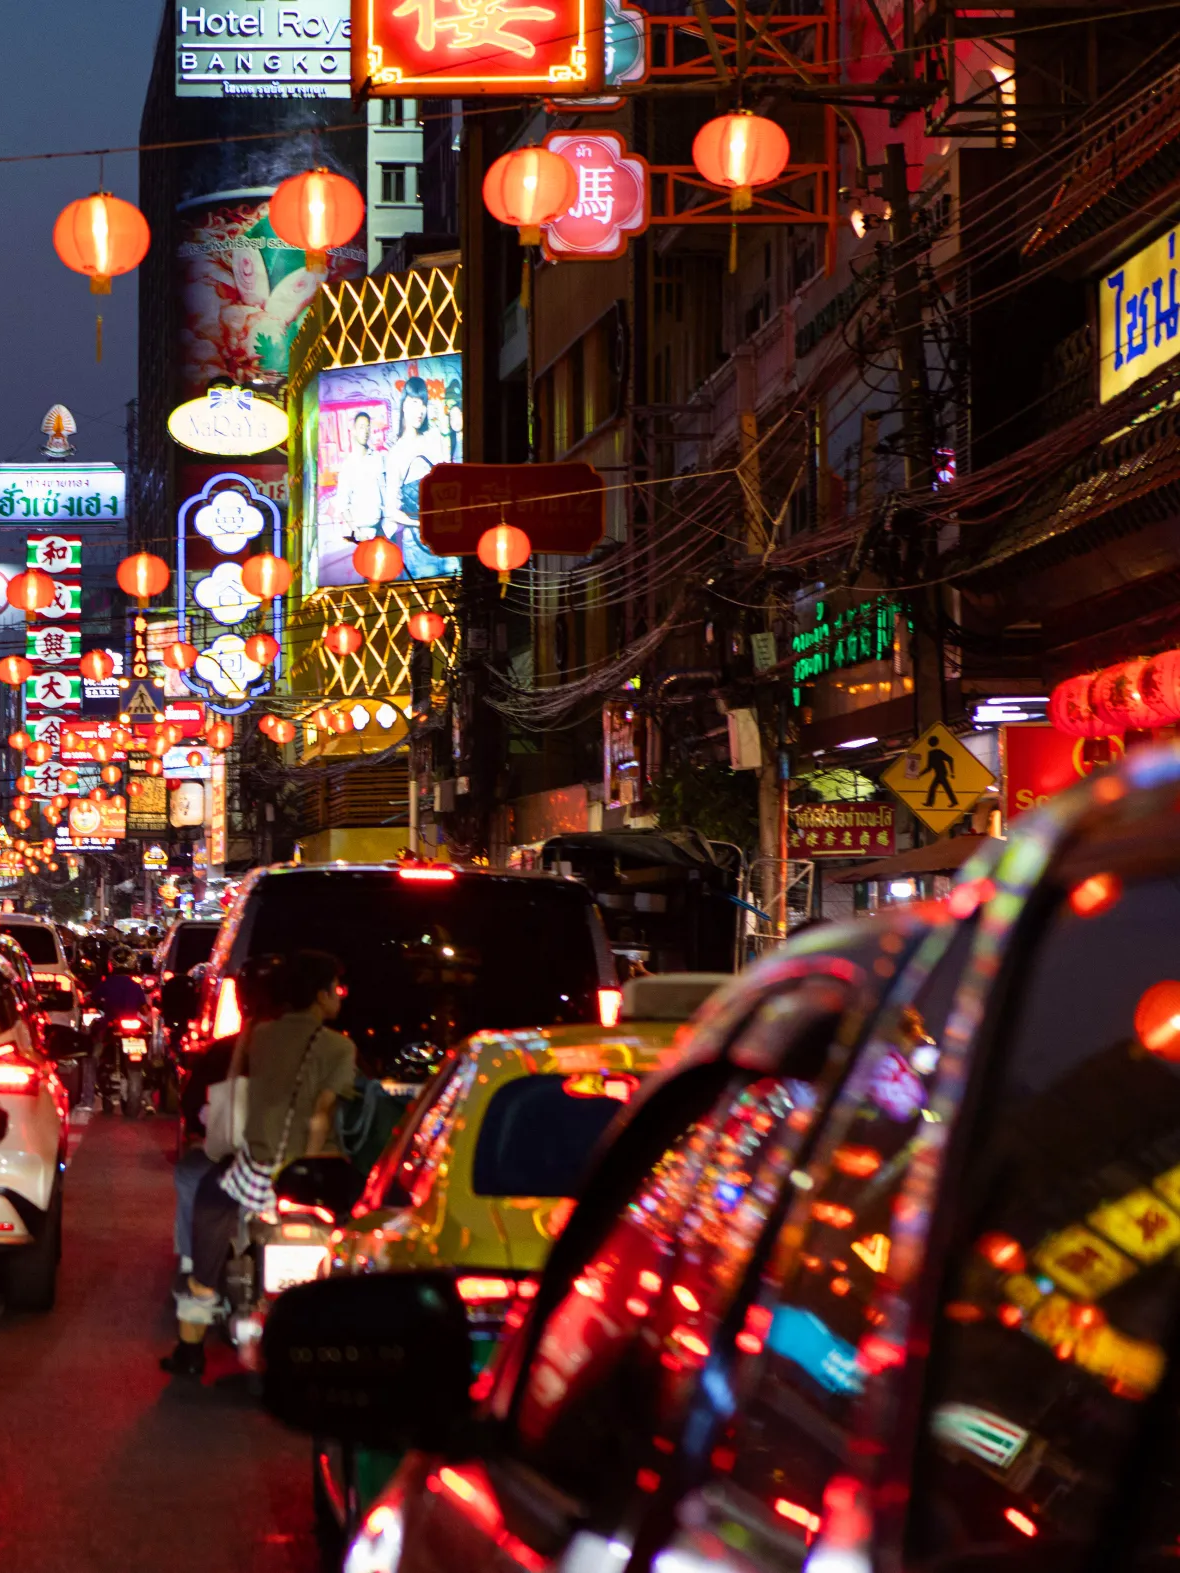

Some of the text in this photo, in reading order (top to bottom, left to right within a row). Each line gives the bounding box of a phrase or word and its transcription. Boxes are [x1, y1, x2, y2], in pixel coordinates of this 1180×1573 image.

[180, 6, 264, 37] Hotel
[575, 143, 593, 158] ม้า
[557, 164, 616, 225] 馬
[187, 412, 270, 440] NaRaYa
